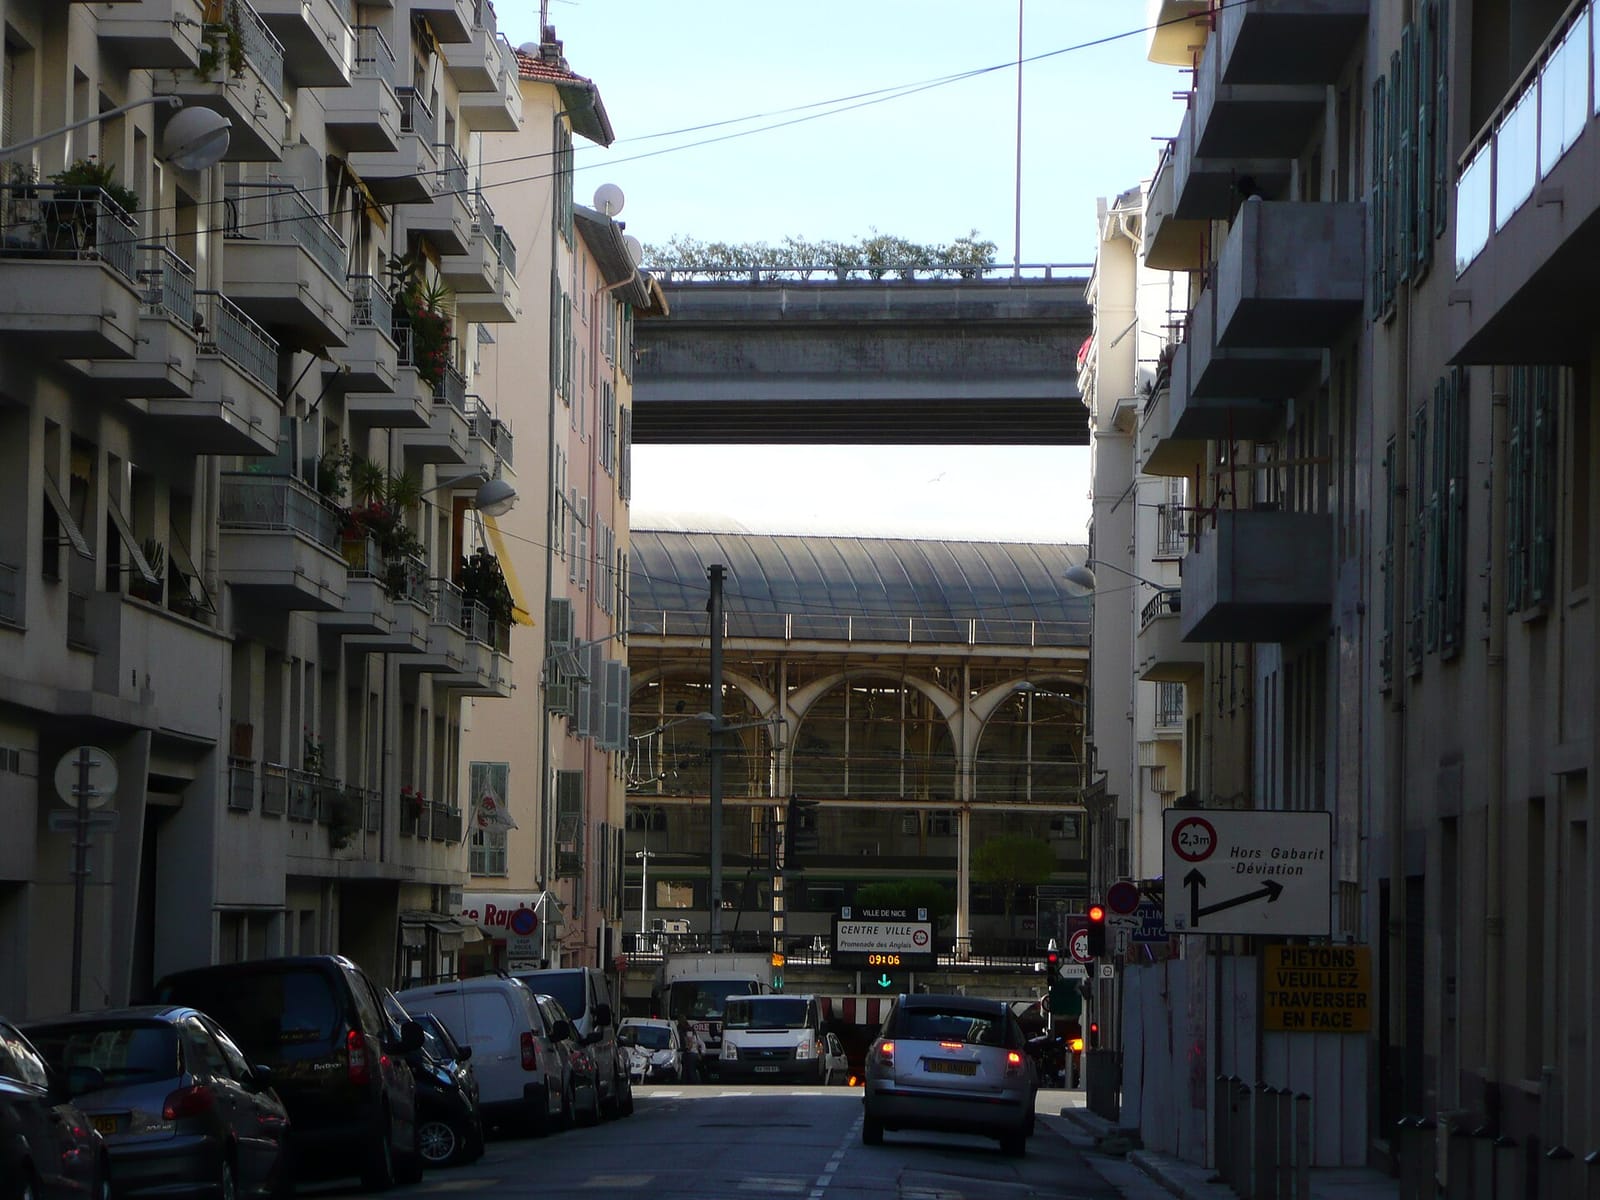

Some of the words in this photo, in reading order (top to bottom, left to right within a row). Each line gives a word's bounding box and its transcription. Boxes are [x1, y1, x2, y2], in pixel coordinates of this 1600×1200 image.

[1180, 833, 1209, 846] 2,3m
[1230, 847, 1261, 858] Hors
[1271, 847, 1324, 860] Gabarit
[862, 909, 879, 917] VILLE
[891, 910, 906, 918] NICE
[841, 926, 879, 935] CENTRE
[885, 926, 911, 935] VILLE
[840, 940, 874, 948] Promenade
[889, 941, 911, 949] Anglais
[869, 955, 900, 965] 09:06
[1281, 948, 1355, 967] PIETONS
[1277, 972, 1359, 988] VEUILLEZ
[1267, 991, 1367, 1008] TRAVERSER
[1283, 1011, 1305, 1027] EN
[1312, 1011, 1353, 1028] FACE
